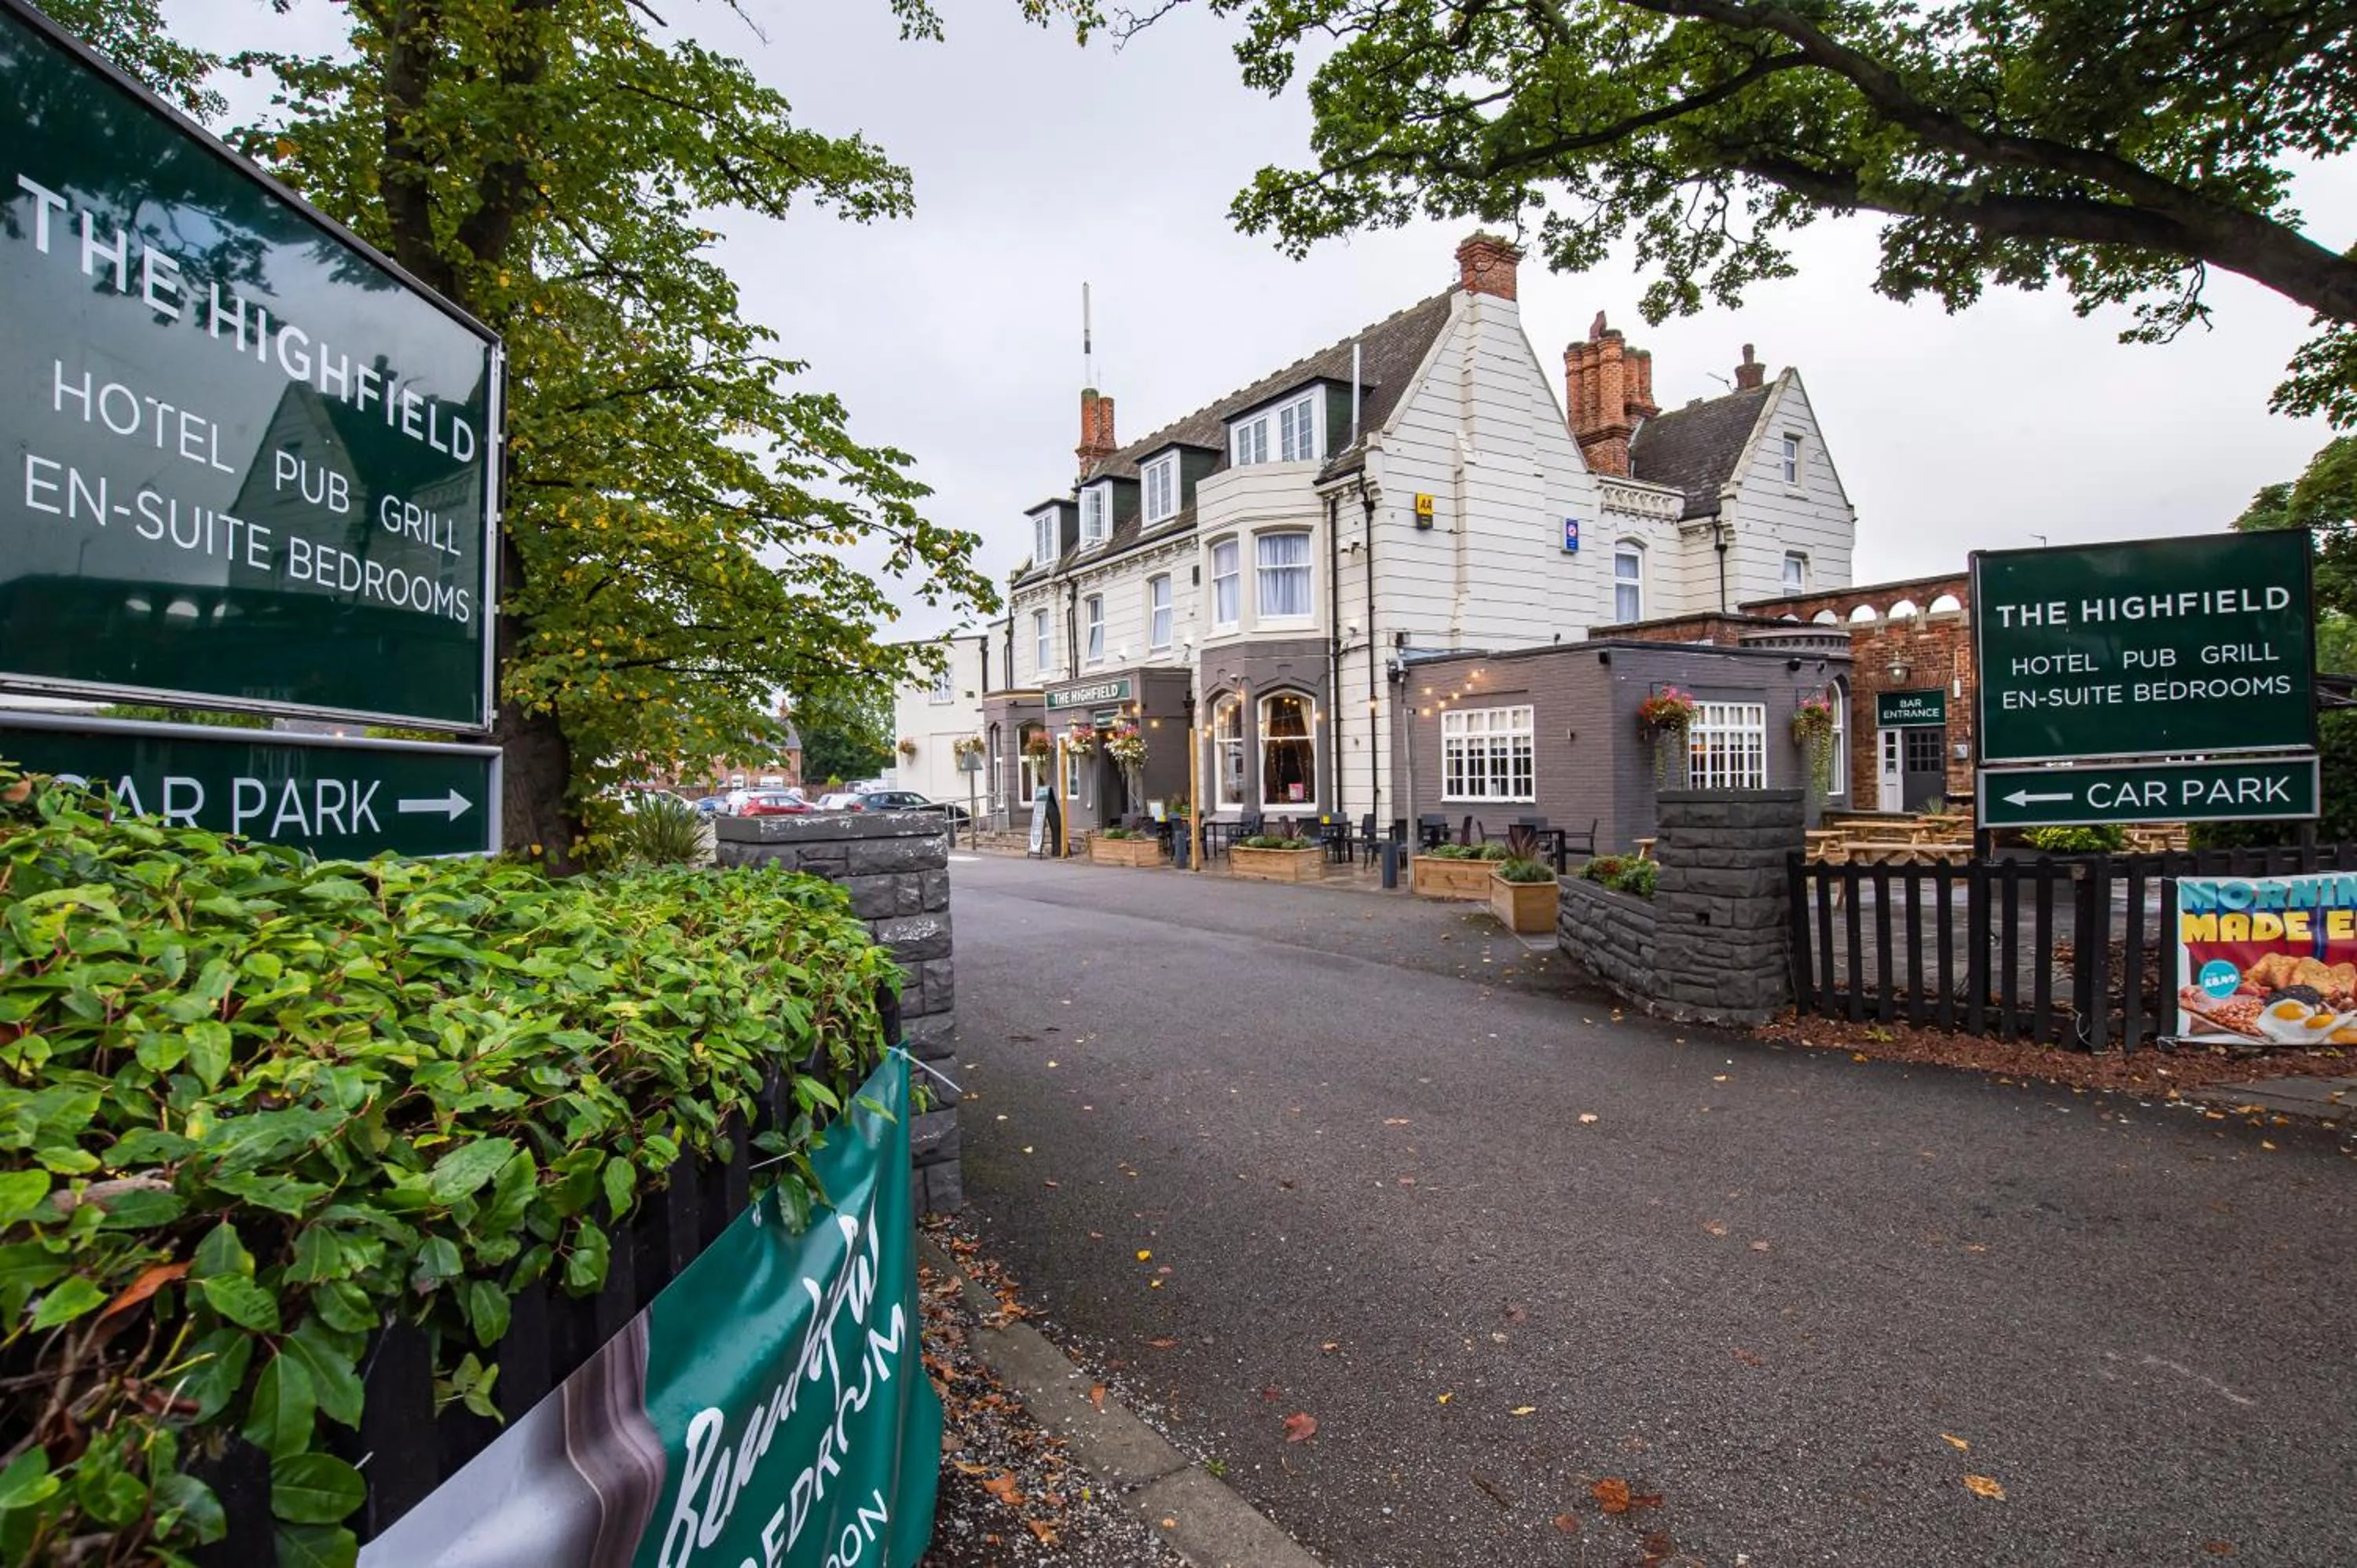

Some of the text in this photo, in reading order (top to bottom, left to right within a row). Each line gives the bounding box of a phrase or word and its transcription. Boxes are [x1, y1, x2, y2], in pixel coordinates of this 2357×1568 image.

[18, 174, 475, 463] THE HIGHFIELD
[54, 360, 462, 556] HOTEL PUB GRILL
[26, 454, 470, 623] EN-SUITE BEDROOMS
[1996, 587, 2290, 628] THE HIGHFIELD
[2012, 643, 2279, 676] HOTEL PUB GRILL
[1054, 684, 1119, 705] THE HIGHFIELD
[1900, 698, 1923, 708] BAR
[2002, 676, 2291, 709] EN-SUITE BEDROOMS
[1883, 708, 1940, 719] ENTRANCE
[233, 778, 382, 839] PARK
[2087, 776, 2290, 809] CAR PARK
[2182, 910, 2357, 943] MADE E
